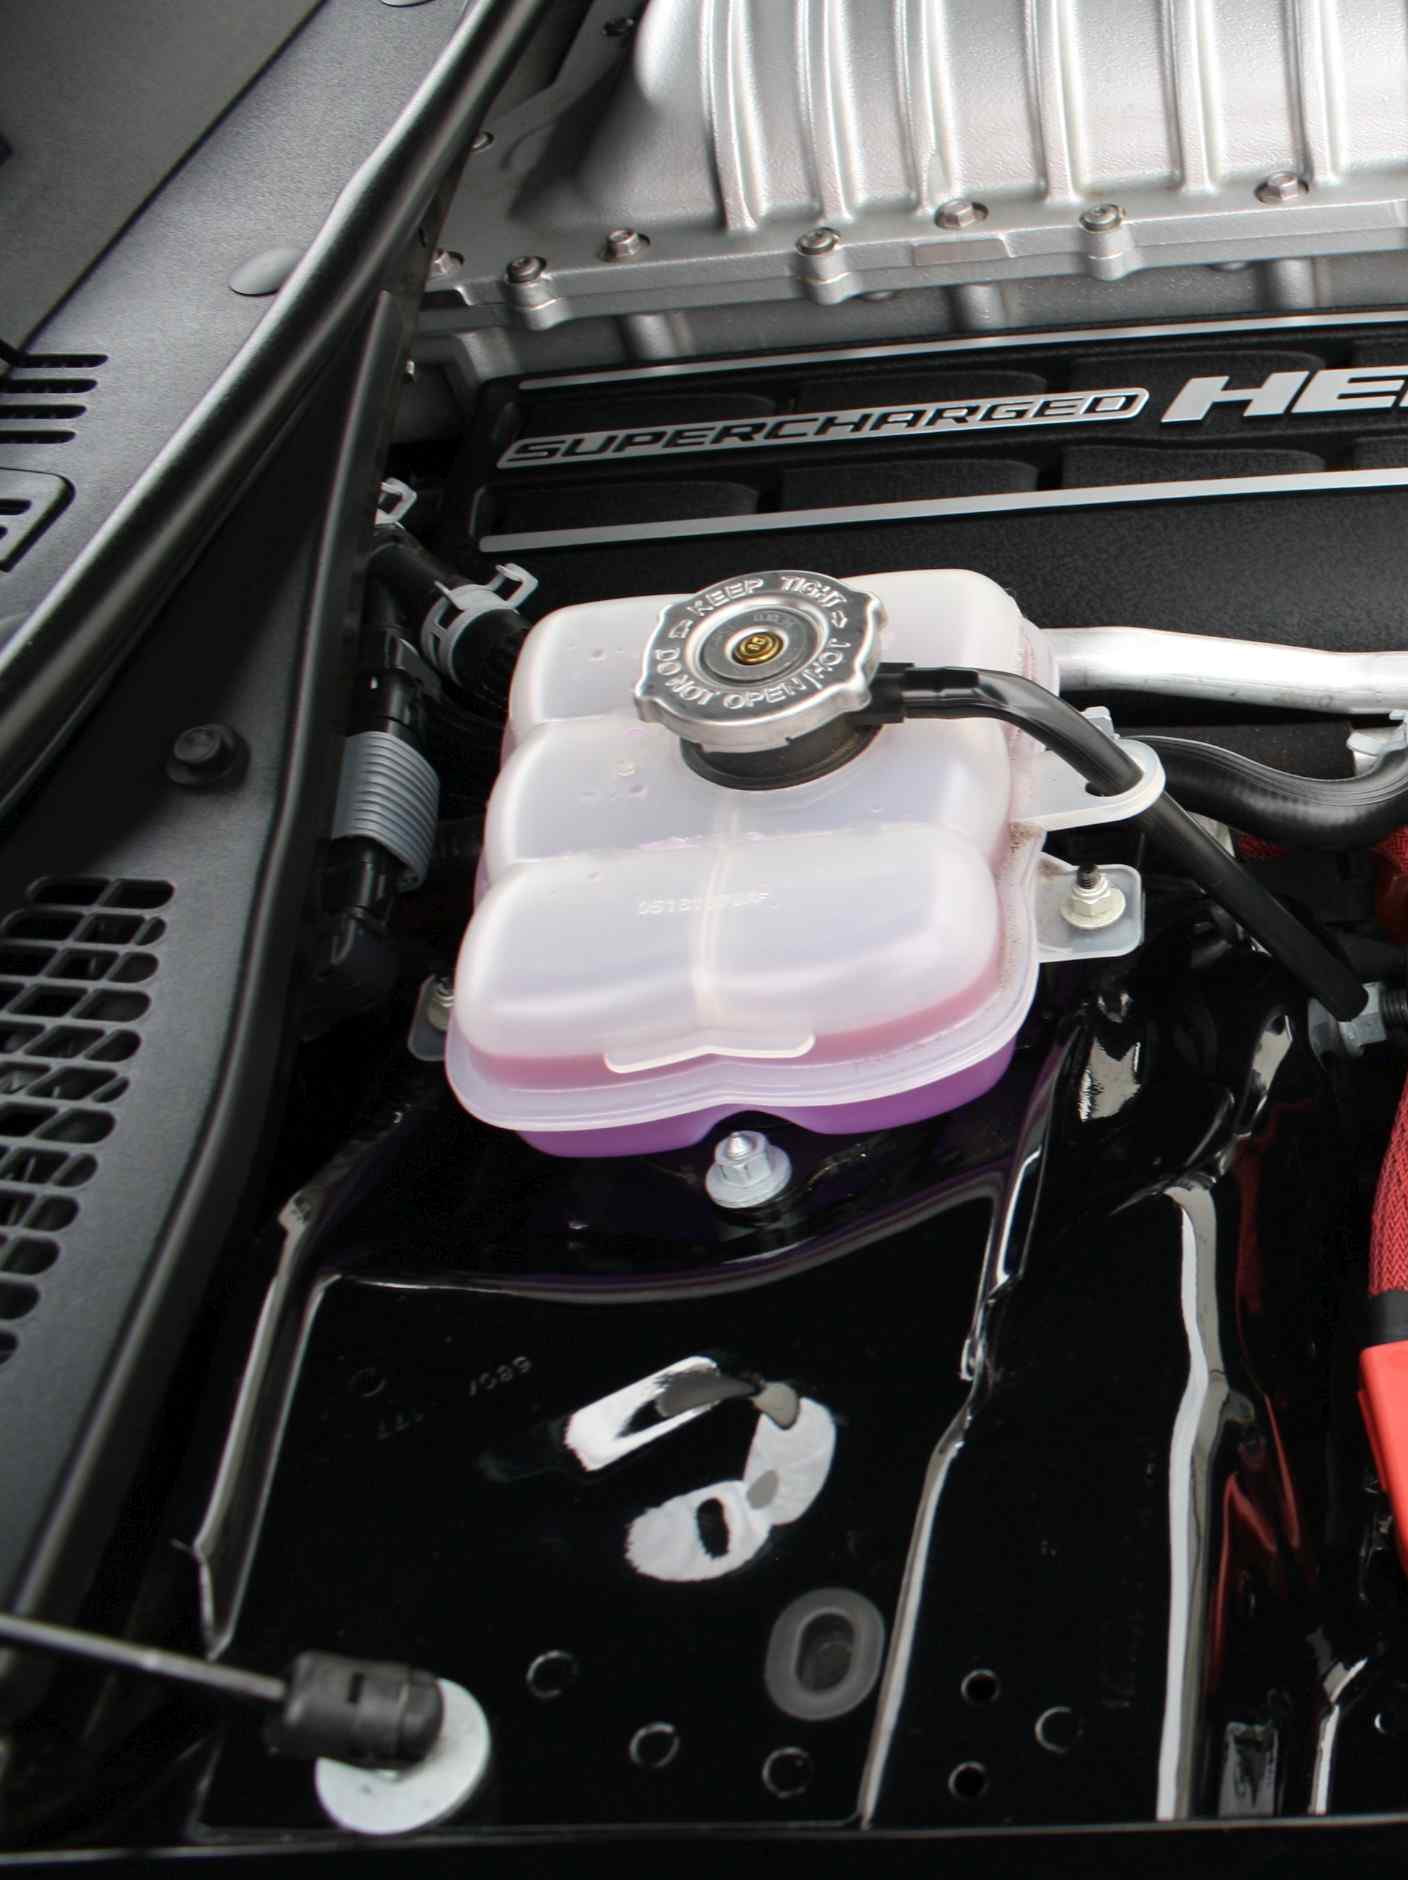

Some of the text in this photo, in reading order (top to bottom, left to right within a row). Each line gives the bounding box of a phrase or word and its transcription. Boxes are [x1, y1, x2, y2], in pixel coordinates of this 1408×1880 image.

[505, 393, 1140, 463] SUPERCHARGED
[686, 575, 848, 617] KEEP TIGHT
[655, 647, 682, 676] DO
[665, 674, 721, 706] NOT
[722, 676, 808, 710] OPEN
